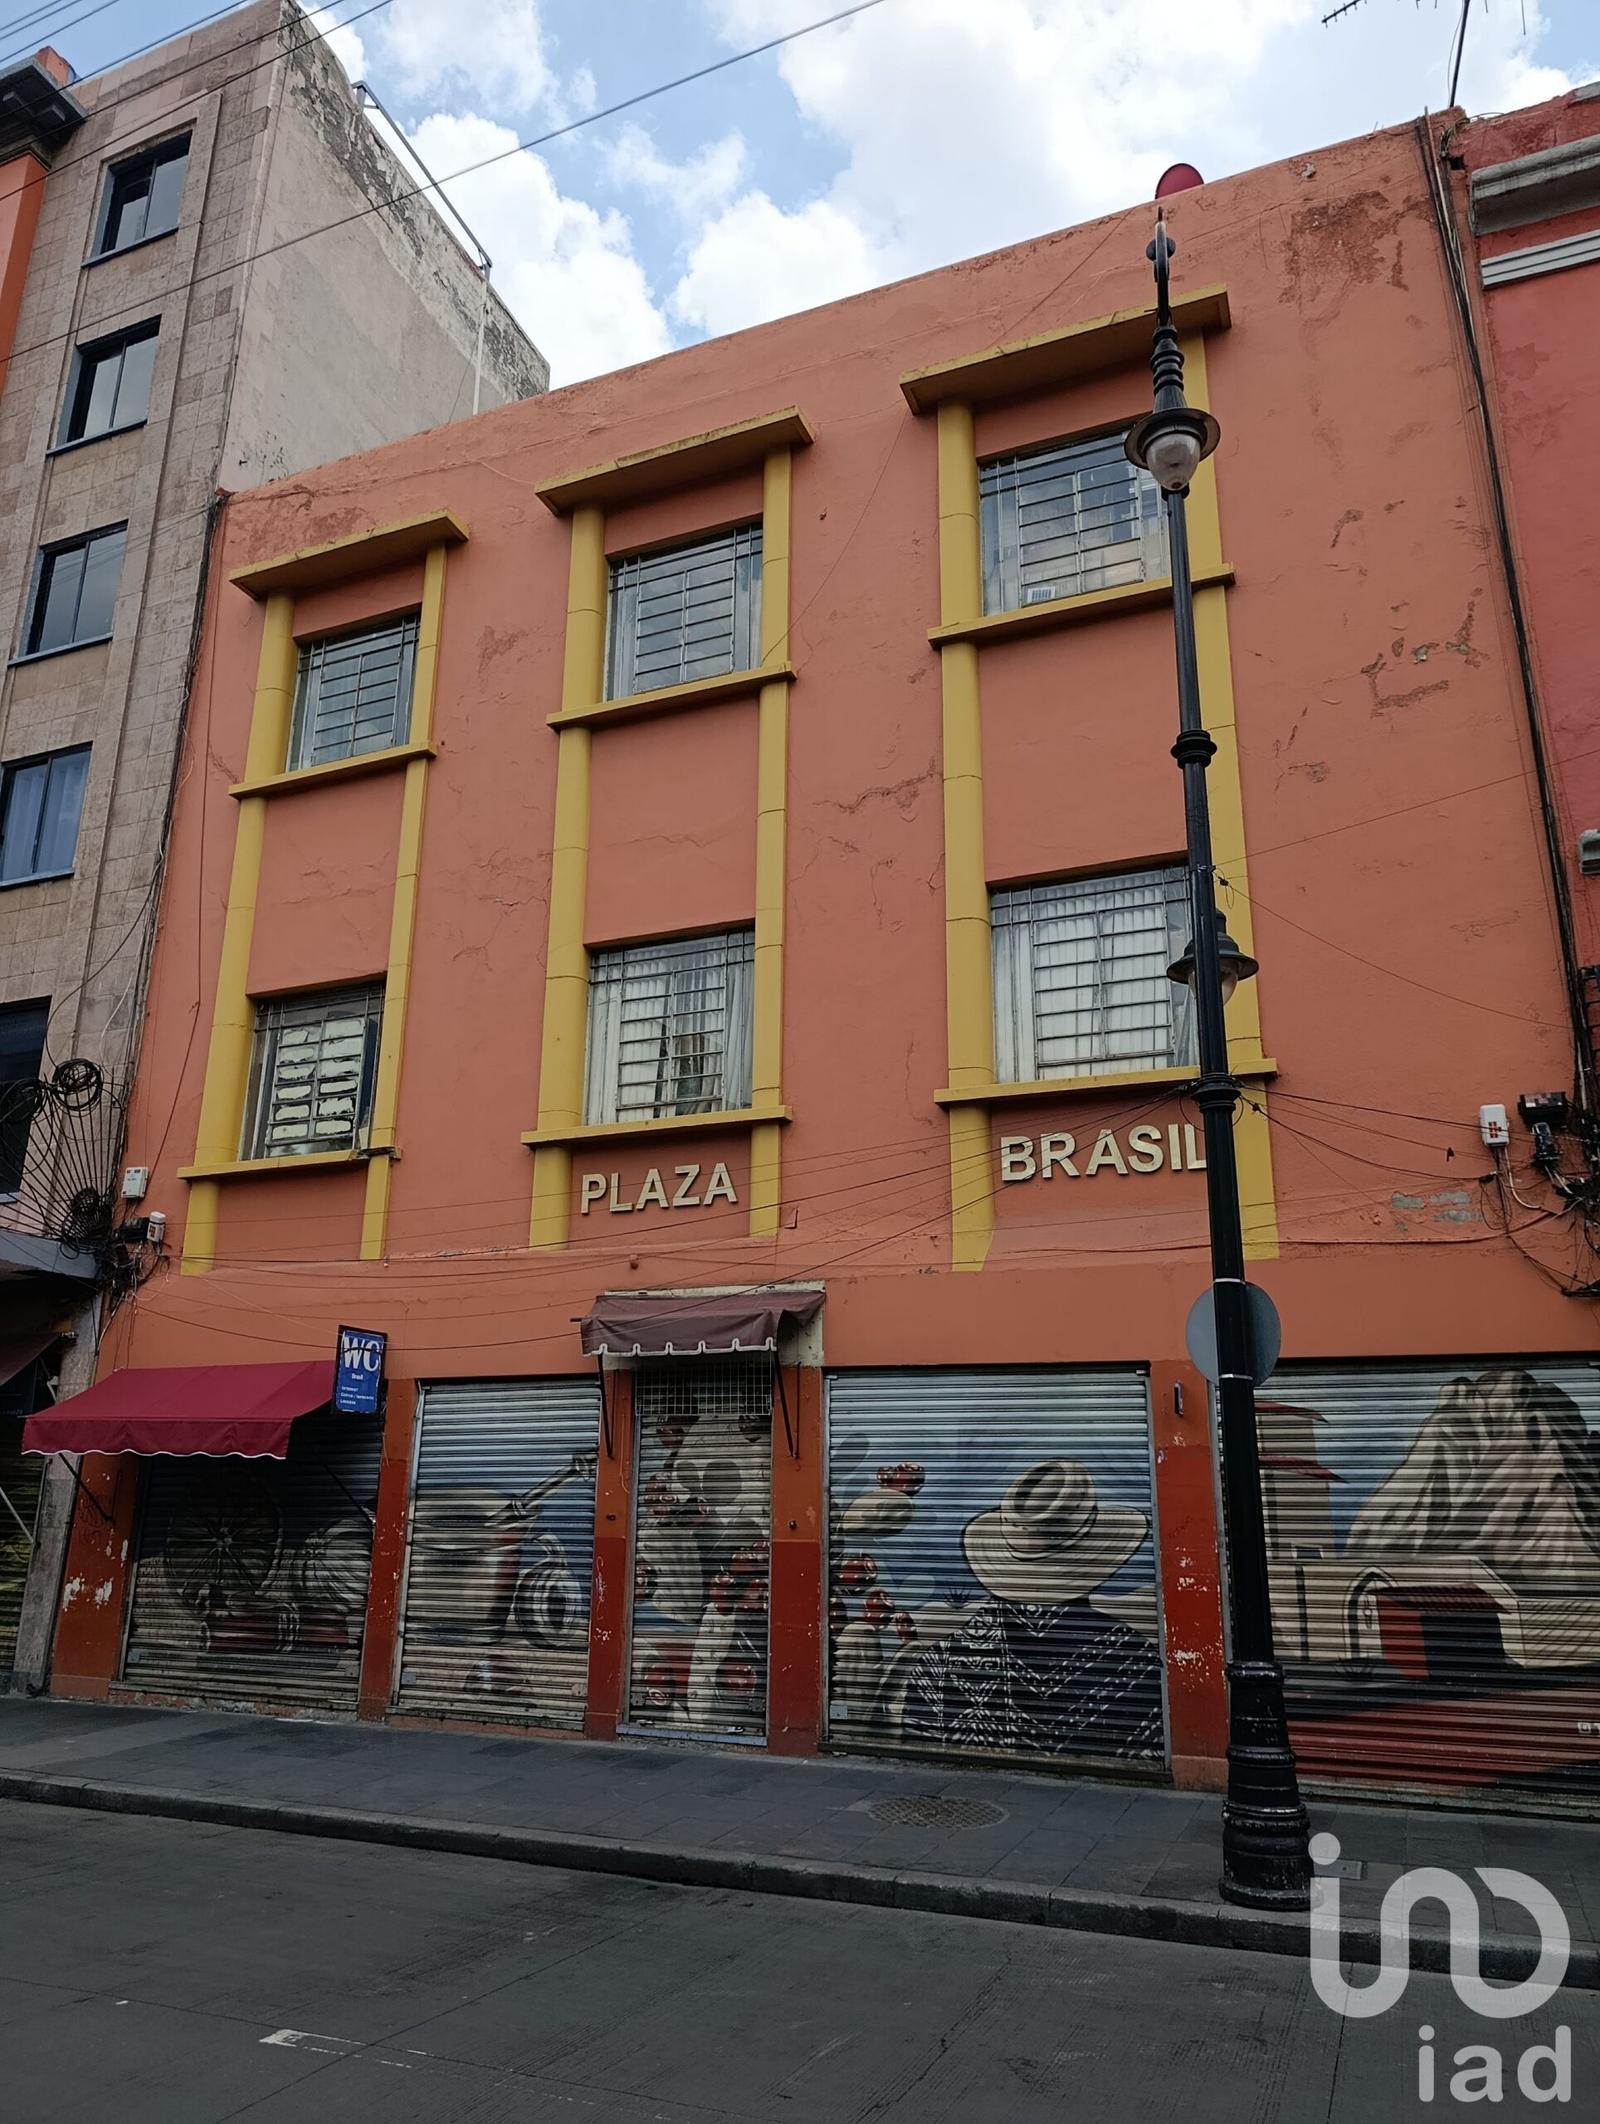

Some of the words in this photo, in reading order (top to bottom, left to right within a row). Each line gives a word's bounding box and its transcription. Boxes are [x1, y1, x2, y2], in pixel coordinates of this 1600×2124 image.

[580, 1162, 738, 1214] PLAZA
[1000, 1124, 1207, 1181] BRASIL
[343, 1336, 379, 1371] WC
